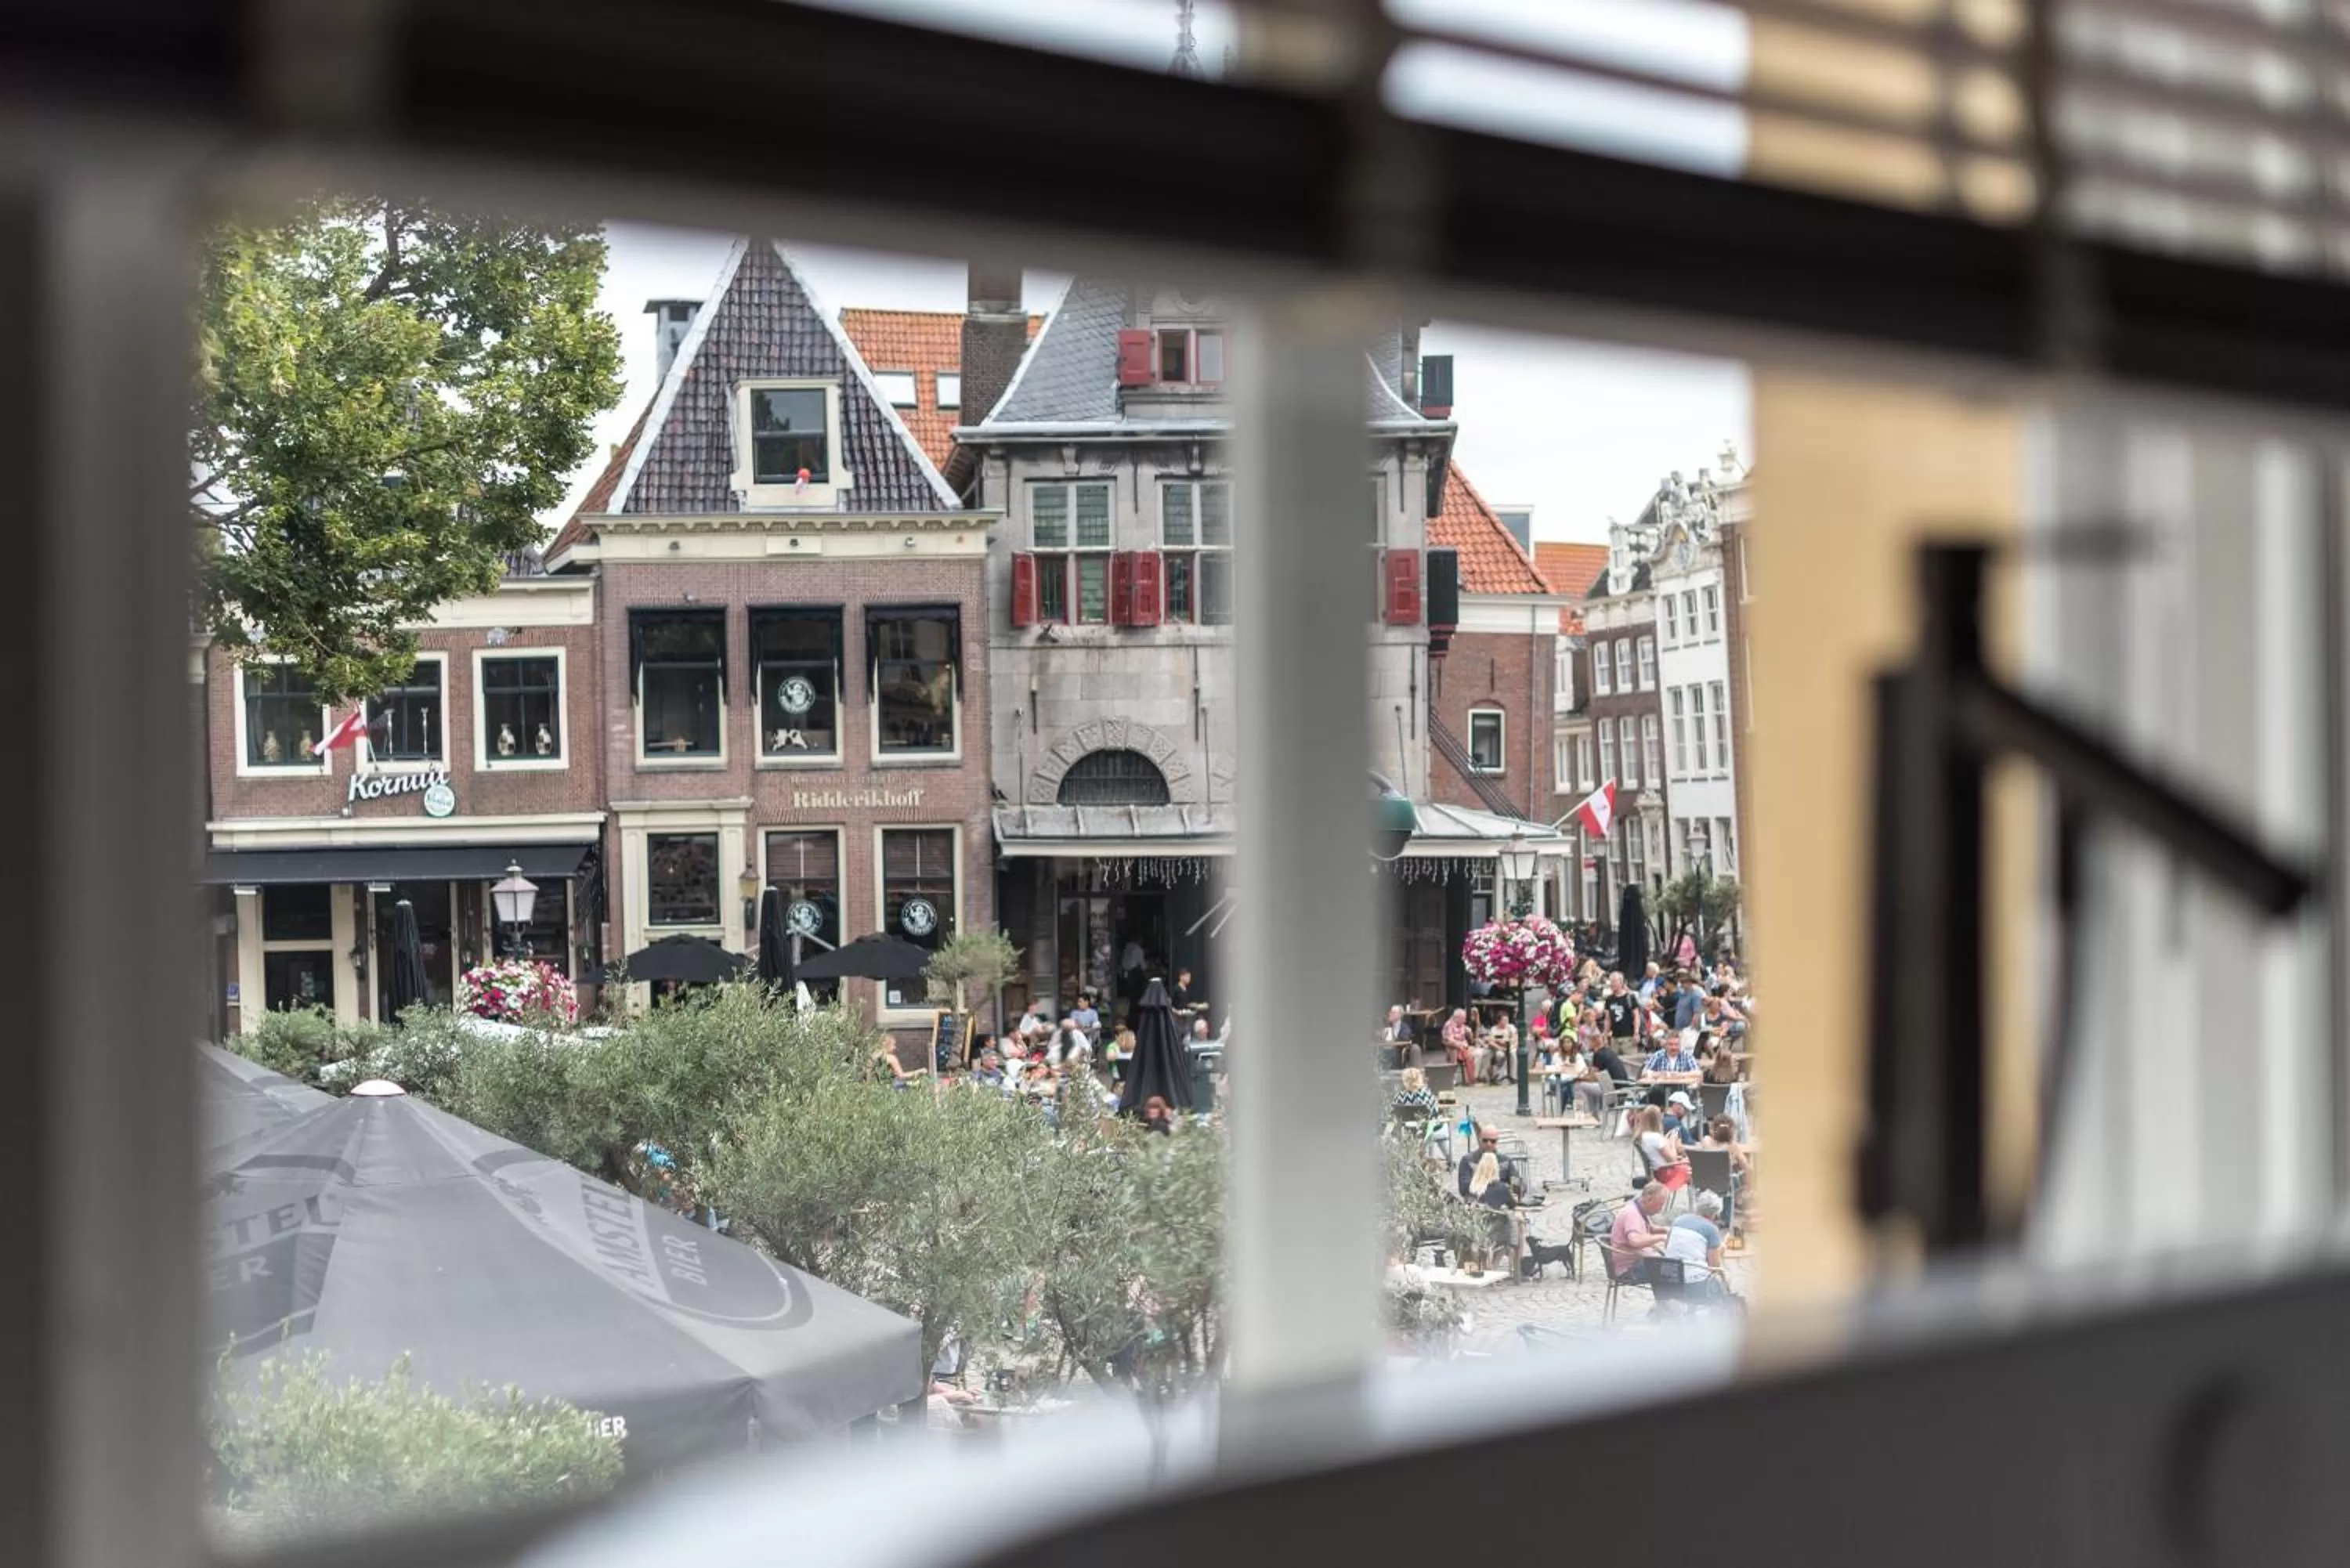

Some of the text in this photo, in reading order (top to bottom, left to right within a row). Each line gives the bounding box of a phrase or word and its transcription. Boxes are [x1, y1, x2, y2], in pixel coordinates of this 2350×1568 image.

[793, 789, 925, 808] Ridderikhoff
[212, 1194, 342, 1250] TEL
[661, 1234, 707, 1287] BIER
